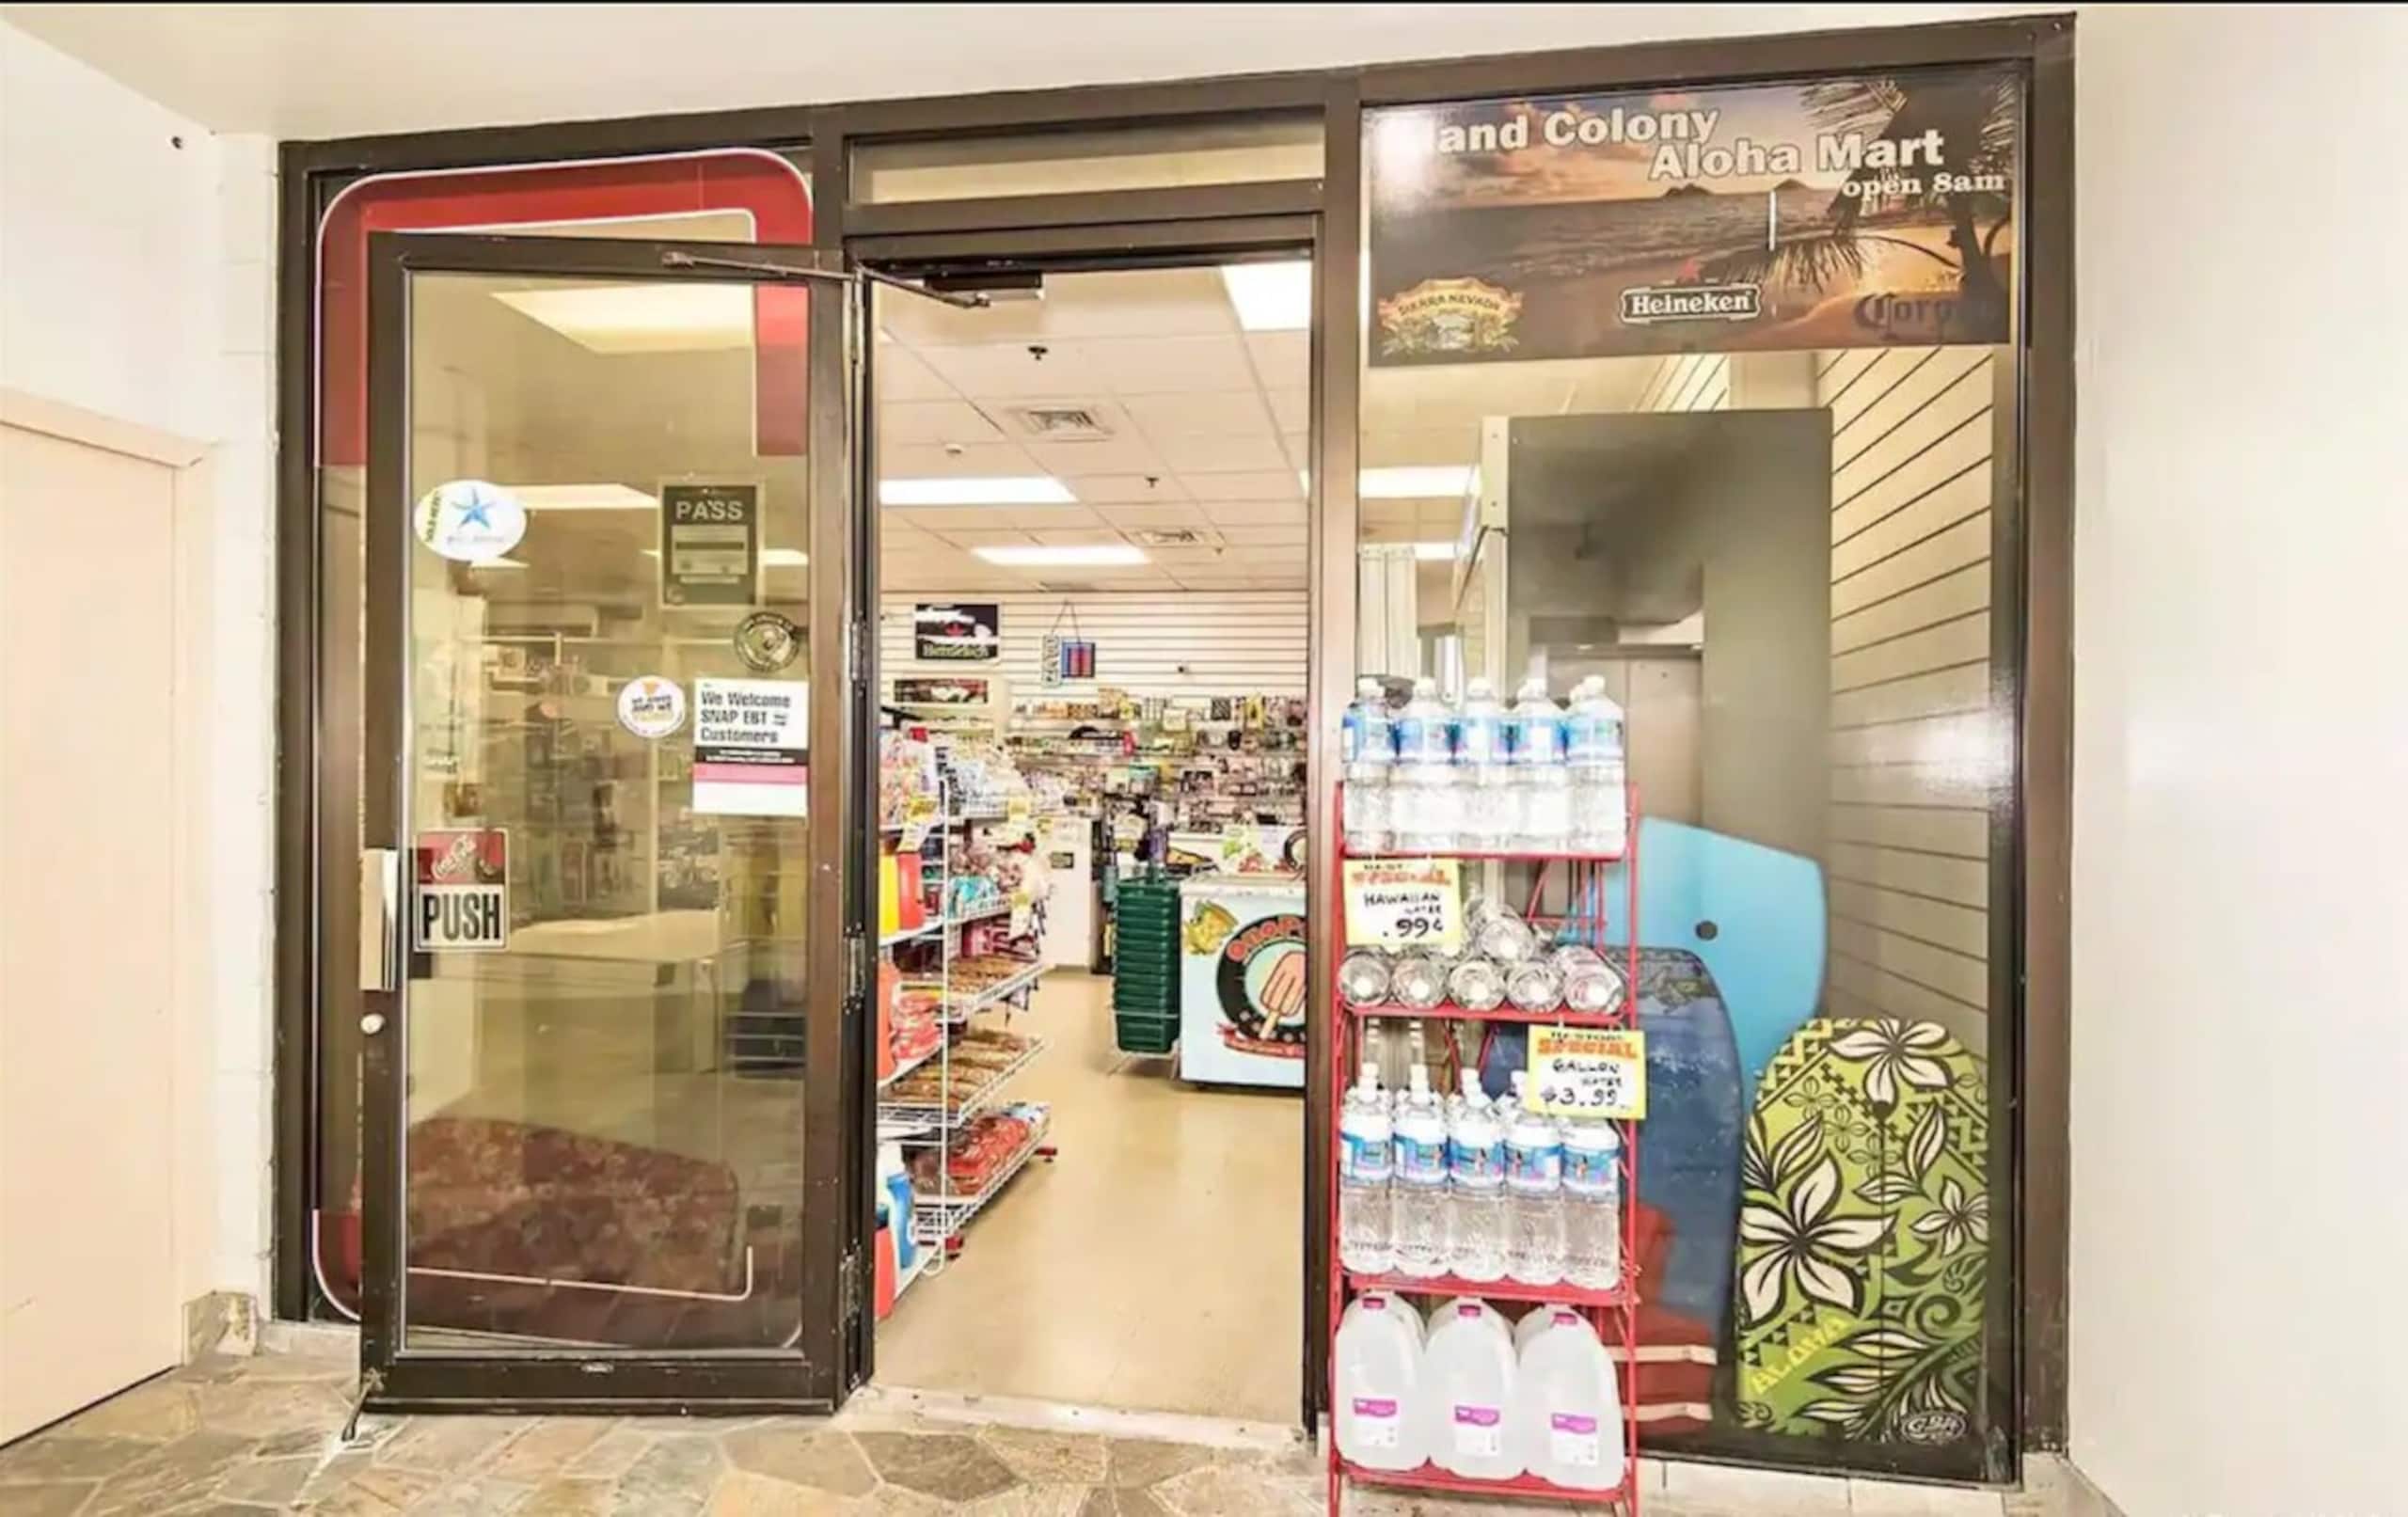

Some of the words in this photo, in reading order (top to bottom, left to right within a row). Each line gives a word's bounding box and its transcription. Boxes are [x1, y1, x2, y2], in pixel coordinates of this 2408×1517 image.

[1437, 114, 1529, 154] and
[1543, 106, 1719, 147] Colony
[1648, 137, 1802, 181] Aloha
[1816, 128, 1945, 173] Mart
[1842, 176, 1923, 201] open
[1932, 170, 2005, 193] 8am
[1630, 291, 1749, 317] Heineken
[675, 499, 744, 520] PASS
[701, 690, 723, 705] We
[727, 691, 791, 708] Welcome
[701, 708, 739, 724] SNAP
[743, 710, 768, 725] EBT
[701, 726, 779, 743] Customers
[1363, 892, 1440, 907] HAWAIIAN
[422, 893, 500, 940] PUSH
[1537, 1038, 1638, 1059] SPECIAL
